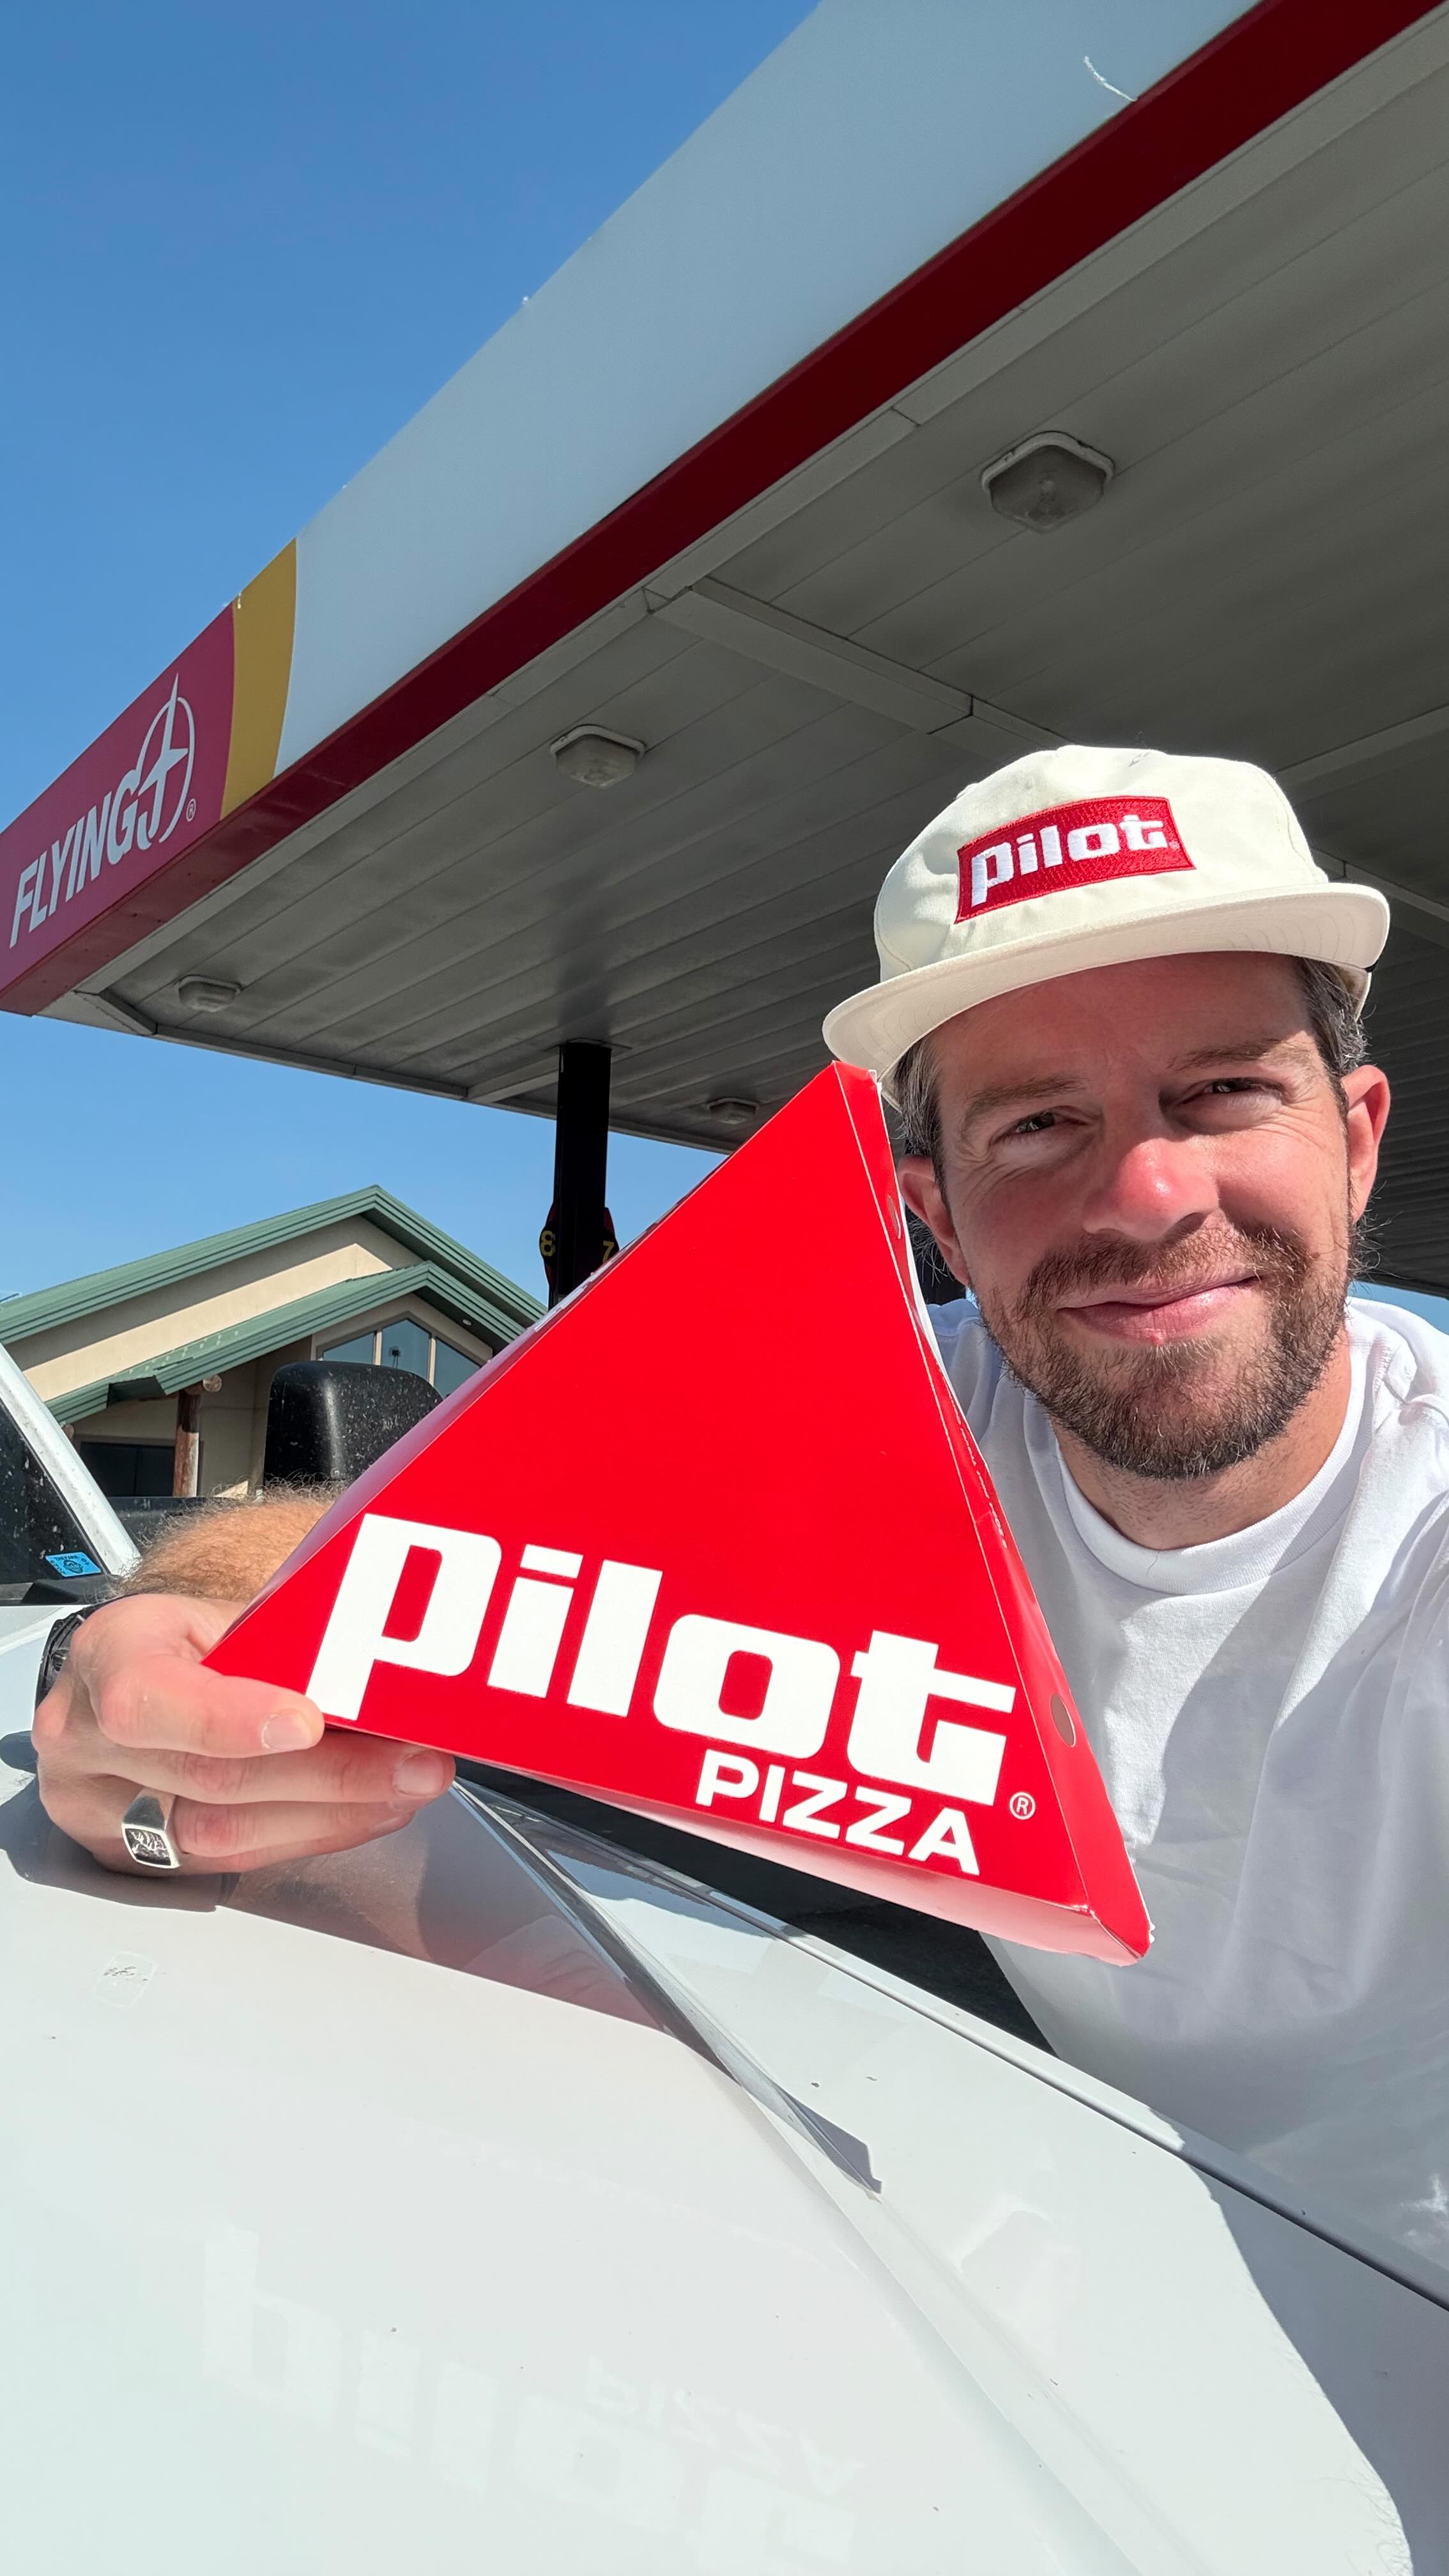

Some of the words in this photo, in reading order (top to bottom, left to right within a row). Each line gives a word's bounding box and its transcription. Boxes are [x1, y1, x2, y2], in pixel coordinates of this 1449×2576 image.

[971, 815, 1169, 907] pilot
[540, 1230, 556, 1257] 8
[602, 1240, 615, 1264] 7
[305, 1513, 1016, 1806] pilot
[695, 1749, 980, 1876] PIZZA
